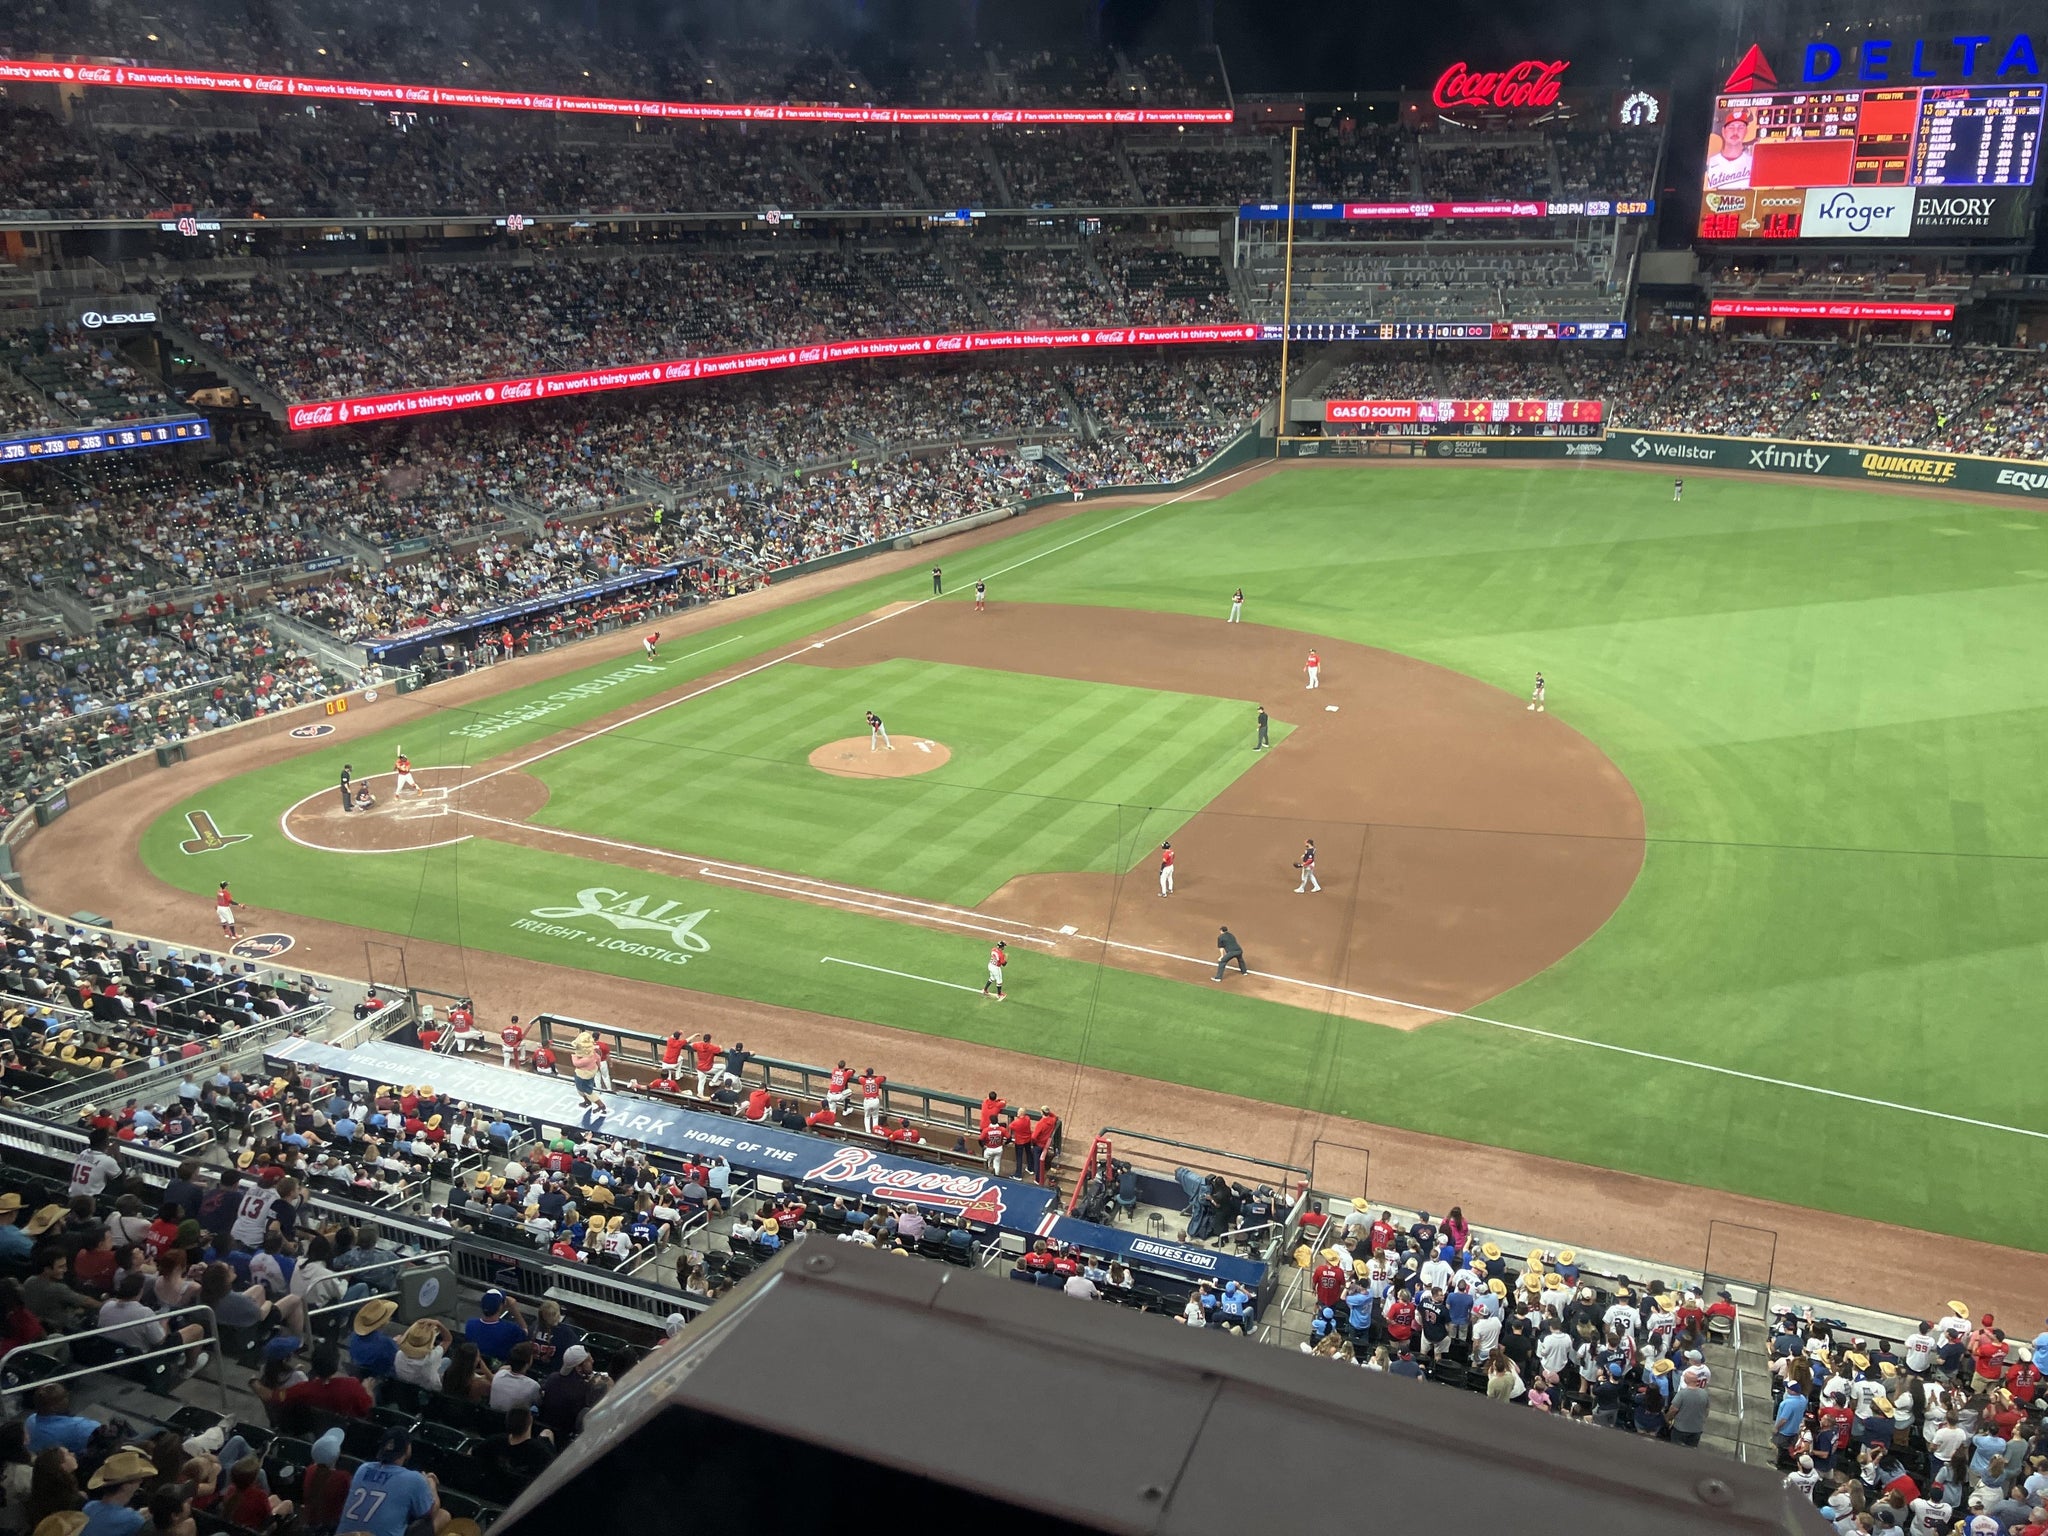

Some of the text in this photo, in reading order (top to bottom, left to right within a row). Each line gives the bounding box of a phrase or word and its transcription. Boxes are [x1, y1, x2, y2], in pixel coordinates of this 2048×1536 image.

[1802, 33, 2040, 83] DELTA
[0, 66, 61, 78] hirsty work
[128, 72, 241, 87] Fan work is thirsty work
[1923, 104, 1933, 115] 13
[1825, 125, 1838, 136] 23
[1720, 196, 1744, 206] MEGA
[1917, 199, 1996, 216] EMORY
[1568, 203, 1583, 214] PM
[1819, 192, 1896, 232] Kroger
[507, 214, 523, 230] 44
[766, 211, 780, 224] 47
[1917, 217, 1989, 226] HEALTHCARE
[178, 218, 198, 236] 41
[1764, 229, 1798, 238] MILLION
[103, 312, 156, 324] LEXUS
[990, 336, 1013, 344] work
[1014, 335, 1023, 343] is
[1023, 335, 1057, 346] thirsty
[1058, 334, 1079, 342] work
[843, 346, 860, 354] work
[861, 345, 869, 353] is
[870, 343, 898, 352] thirsty
[899, 342, 921, 350] work
[704, 354, 788, 372] Fan work is thirsty work
[548, 371, 651, 391] Fan work is thirsty work
[354, 391, 483, 416] Fan work is thirsty work
[1333, 407, 1410, 417] GAS SOUTH
[1418, 406, 1435, 417] AL
[1438, 409, 1455, 417] TOR
[157, 428, 167, 440] 11
[177, 424, 201, 437] HR 2
[1403, 424, 1437, 435] MLB+
[1487, 424, 1522, 435] MB+
[1559, 424, 1596, 436] MLB+
[67, 436, 101, 450] OBP .363
[121, 432, 134, 445] 36
[29, 440, 64, 454] OPS .739
[1654, 443, 1716, 460] Wellstar
[1748, 446, 1830, 473] xfinity
[1862, 453, 1956, 477] QUIKRETE
[1886, 472, 1917, 480] America's
[449, 700, 548, 736] CASINOS
[467, 702, 566, 739] CHEROKEE
[530, 887, 712, 952] SAIA
[510, 918, 586, 940] FREIGHT
[596, 937, 693, 965] LOGISTICS
[348, 1053, 441, 1080] WELCOME TO
[684, 1129, 798, 1162] HOME OF THE
[72, 1164, 92, 1184] 15
[805, 1148, 988, 1195] Braves
[240, 1197, 264, 1219] 13
[605, 1240, 618, 1250] 27
[1135, 1241, 1212, 1266] BRAVES.COM
[1373, 1271, 1386, 1280] 28
[1225, 1303, 1237, 1313] 28
[1915, 1344, 1928, 1352] 99
[346, 1487, 387, 1522] 27
